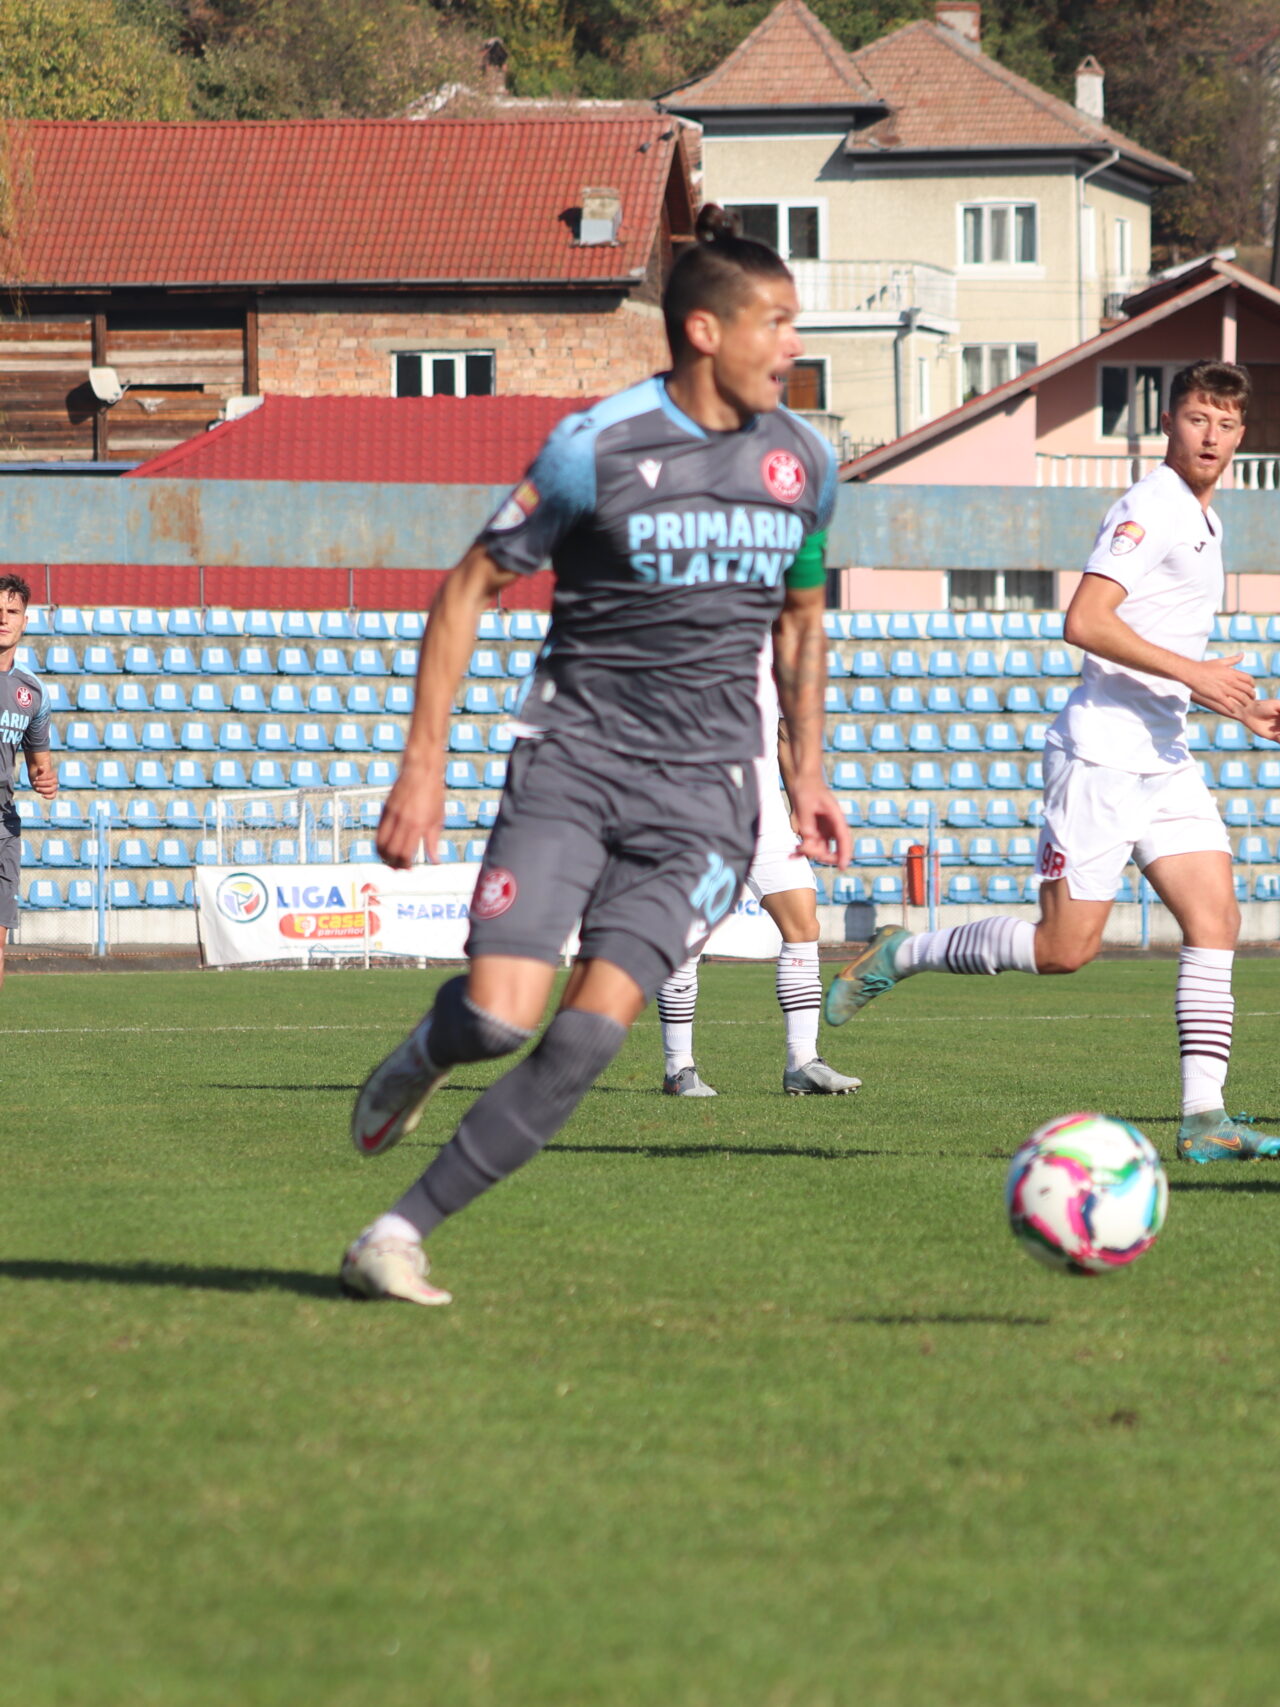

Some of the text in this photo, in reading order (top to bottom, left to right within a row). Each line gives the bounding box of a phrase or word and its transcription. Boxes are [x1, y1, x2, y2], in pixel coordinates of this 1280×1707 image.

[1041, 841, 1066, 878] 98
[276, 885, 347, 909] LIGA
[318, 913, 365, 929] casa
[397, 902, 470, 920] MAREA
